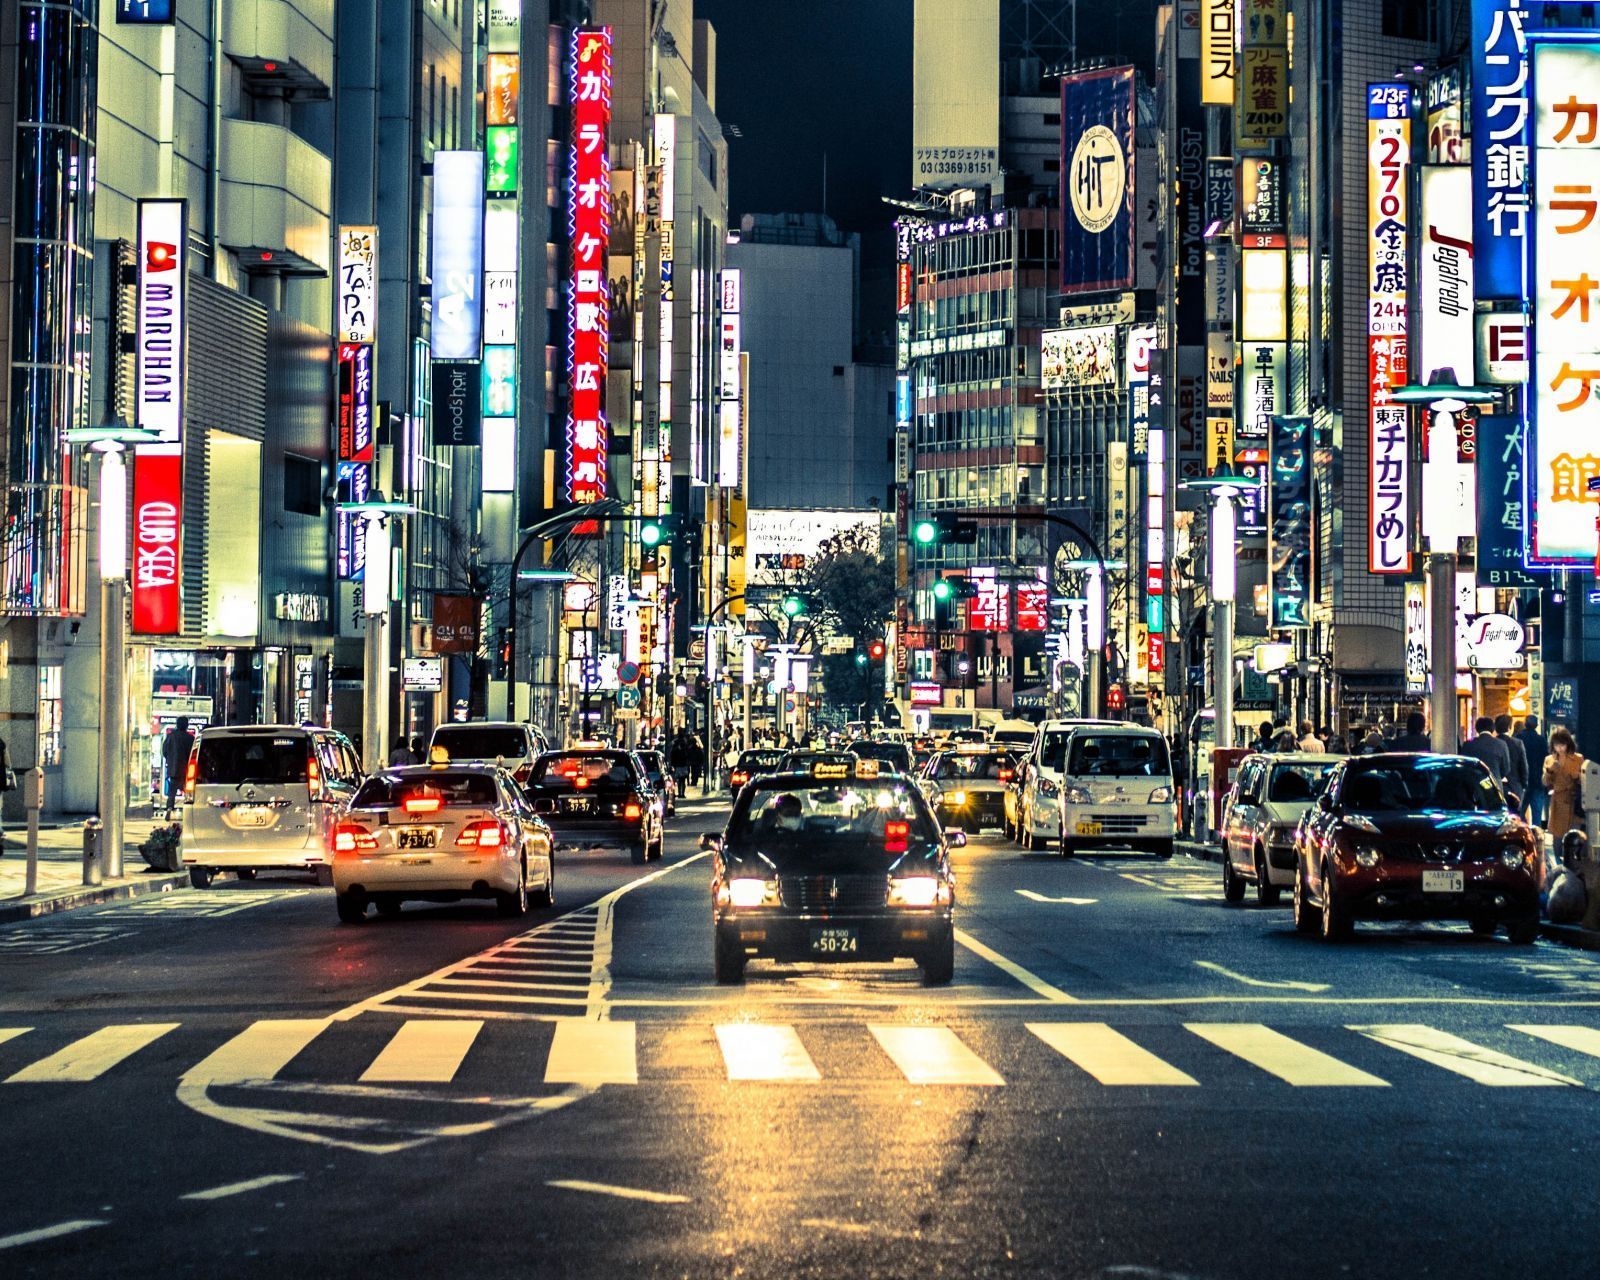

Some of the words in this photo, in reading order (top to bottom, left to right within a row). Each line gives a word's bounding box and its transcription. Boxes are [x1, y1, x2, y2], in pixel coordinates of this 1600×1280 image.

[1246, 49, 1283, 63] フリー
[1251, 65, 1278, 110] 麻雀
[1371, 88, 1408, 104] 2/3F
[1246, 111, 1283, 125] ZOO
[1253, 126, 1277, 136] 4F
[1387, 104, 1407, 118] B1
[577, 70, 601, 263] カラオケ
[920, 162, 992, 173] 03(3369)8151
[1381, 137, 1401, 217] 270
[1183, 204, 1200, 245] Your
[1256, 236, 1272, 247] 3F
[1183, 247, 1200, 276] For
[1429, 225, 1473, 317] Segafredo
[1549, 94, 1600, 504] カラオケ館
[144, 282, 173, 404] MARUHAN
[449, 369, 464, 397] hair
[1209, 370, 1233, 383] NAILS
[648, 411, 657, 453] Euphori
[1180, 376, 1195, 451] LABI
[1376, 408, 1406, 425] 東京
[1376, 425, 1407, 569] チカラめし
[1502, 424, 1523, 531] 大戸屋
[138, 501, 175, 543] CLUB
[138, 544, 175, 588] SEGA
[1490, 571, 1509, 583] B1
[352, 580, 366, 630] 銀行
[977, 656, 1008, 676] LUH
